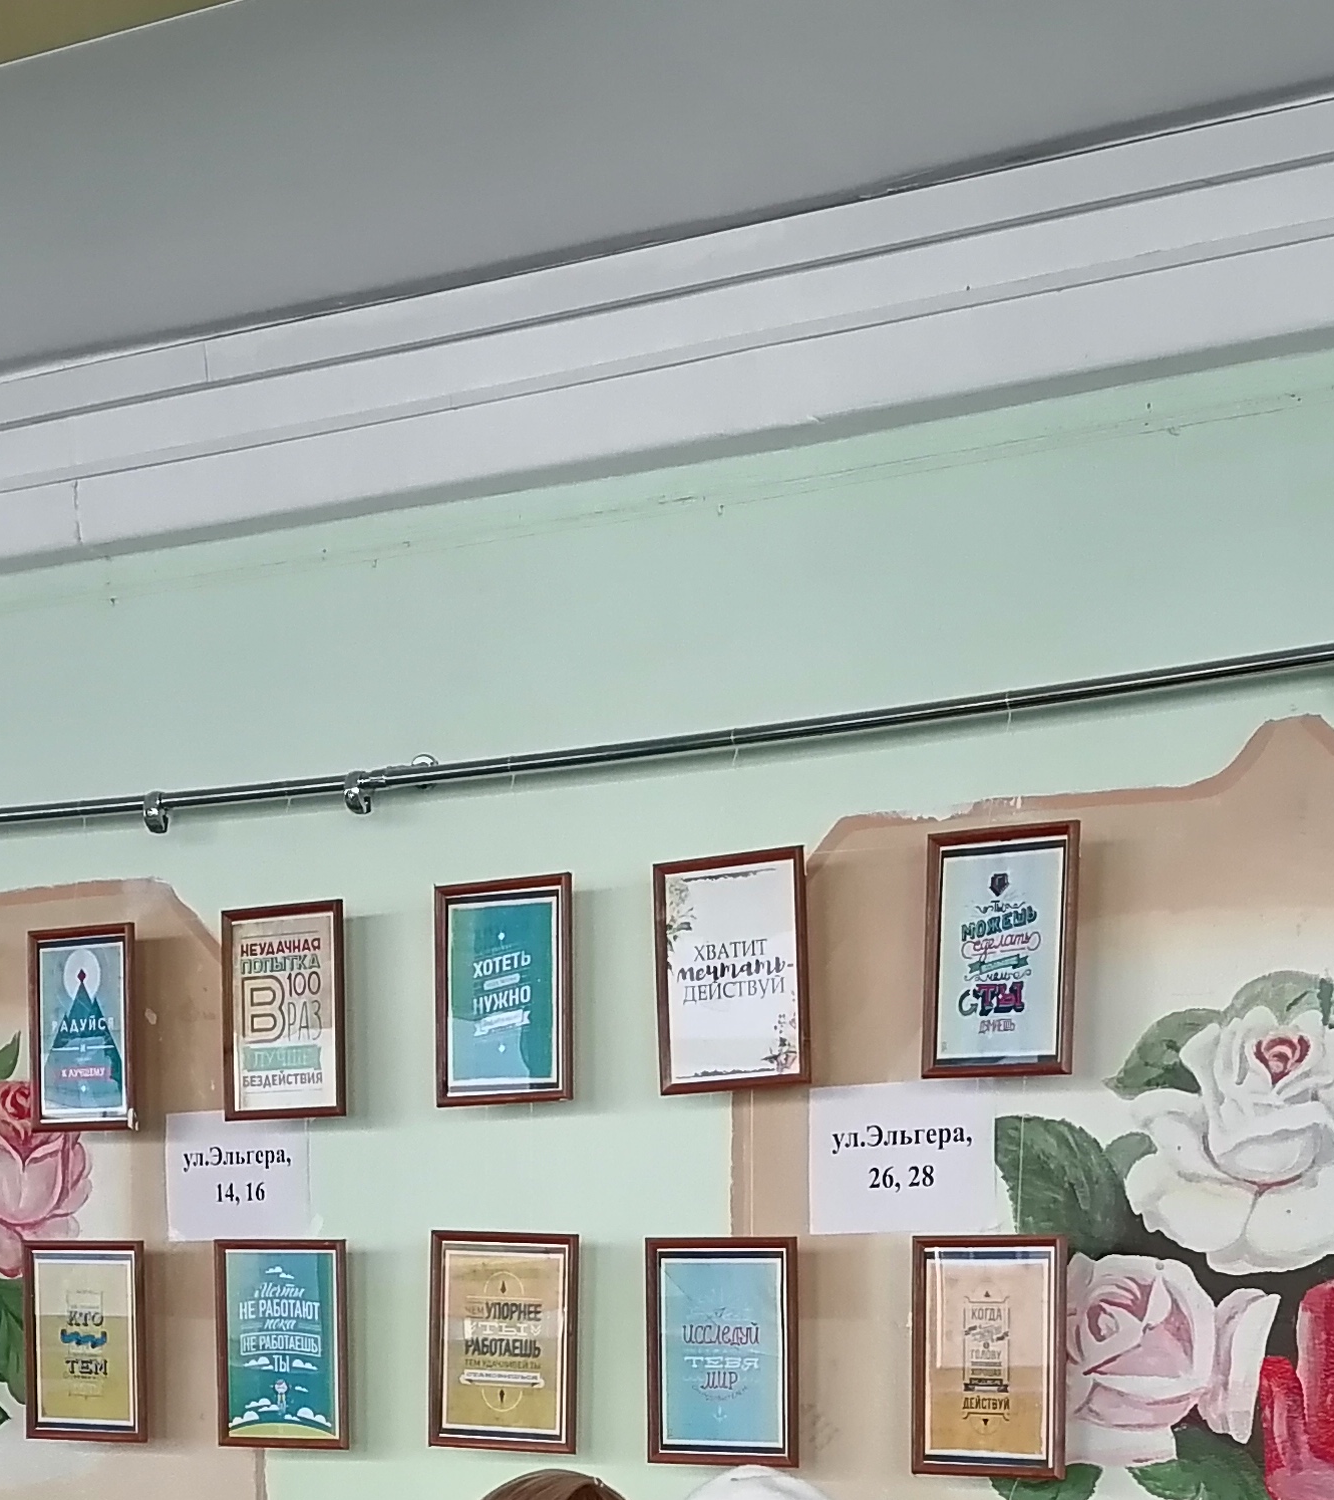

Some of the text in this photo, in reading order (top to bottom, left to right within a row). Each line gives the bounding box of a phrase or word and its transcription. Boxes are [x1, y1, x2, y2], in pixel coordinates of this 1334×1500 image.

[961, 905, 1037, 942] МОЖЕШЬ
[240, 937, 321, 957] НЕУДАЧНАЯ
[693, 938, 768, 962] ХВАТИТ
[241, 953, 321, 975] ПОПЫТКА
[473, 950, 532, 979] ХОТЕТЬ
[473, 985, 532, 1015] НУЖНО
[682, 974, 785, 1005] ДЕЙСТВУЙ
[973, 981, 1025, 1016] ТЫ
[241, 971, 321, 1044] В 100
[51, 1016, 115, 1033] РАДУЙСЯ
[287, 1000, 322, 1042] РАЗ
[253, 1049, 309, 1068] ЛУЧШЕ
[242, 1070, 323, 1088] БЕЗДЕЙСТВИЯ
[831, 1124, 973, 1154] ул.Эльгера,
[183, 1146, 292, 1172] ул.Эльгера,
[868, 1164, 935, 1193] 26, 28
[216, 1181, 266, 1206] 14, 16
[67, 1310, 104, 1327] КТО
[239, 1299, 321, 1321] НЕ РАБОТАЮТ
[484, 1301, 543, 1322] УПОРНЕЕ
[971, 1307, 1003, 1321] КОГДА
[478, 1321, 528, 1336] ТЫ
[242, 1335, 319, 1353] НЕ РАБОТАЕШЬ
[464, 1337, 542, 1358] РАБОТАЕШЬ
[65, 1358, 108, 1375] ТЕМ
[272, 1354, 290, 1373] ТЫ
[465, 1358, 481, 1367] ТЕМ
[962, 1395, 1011, 1411] ДЕЙСТВУЙ
